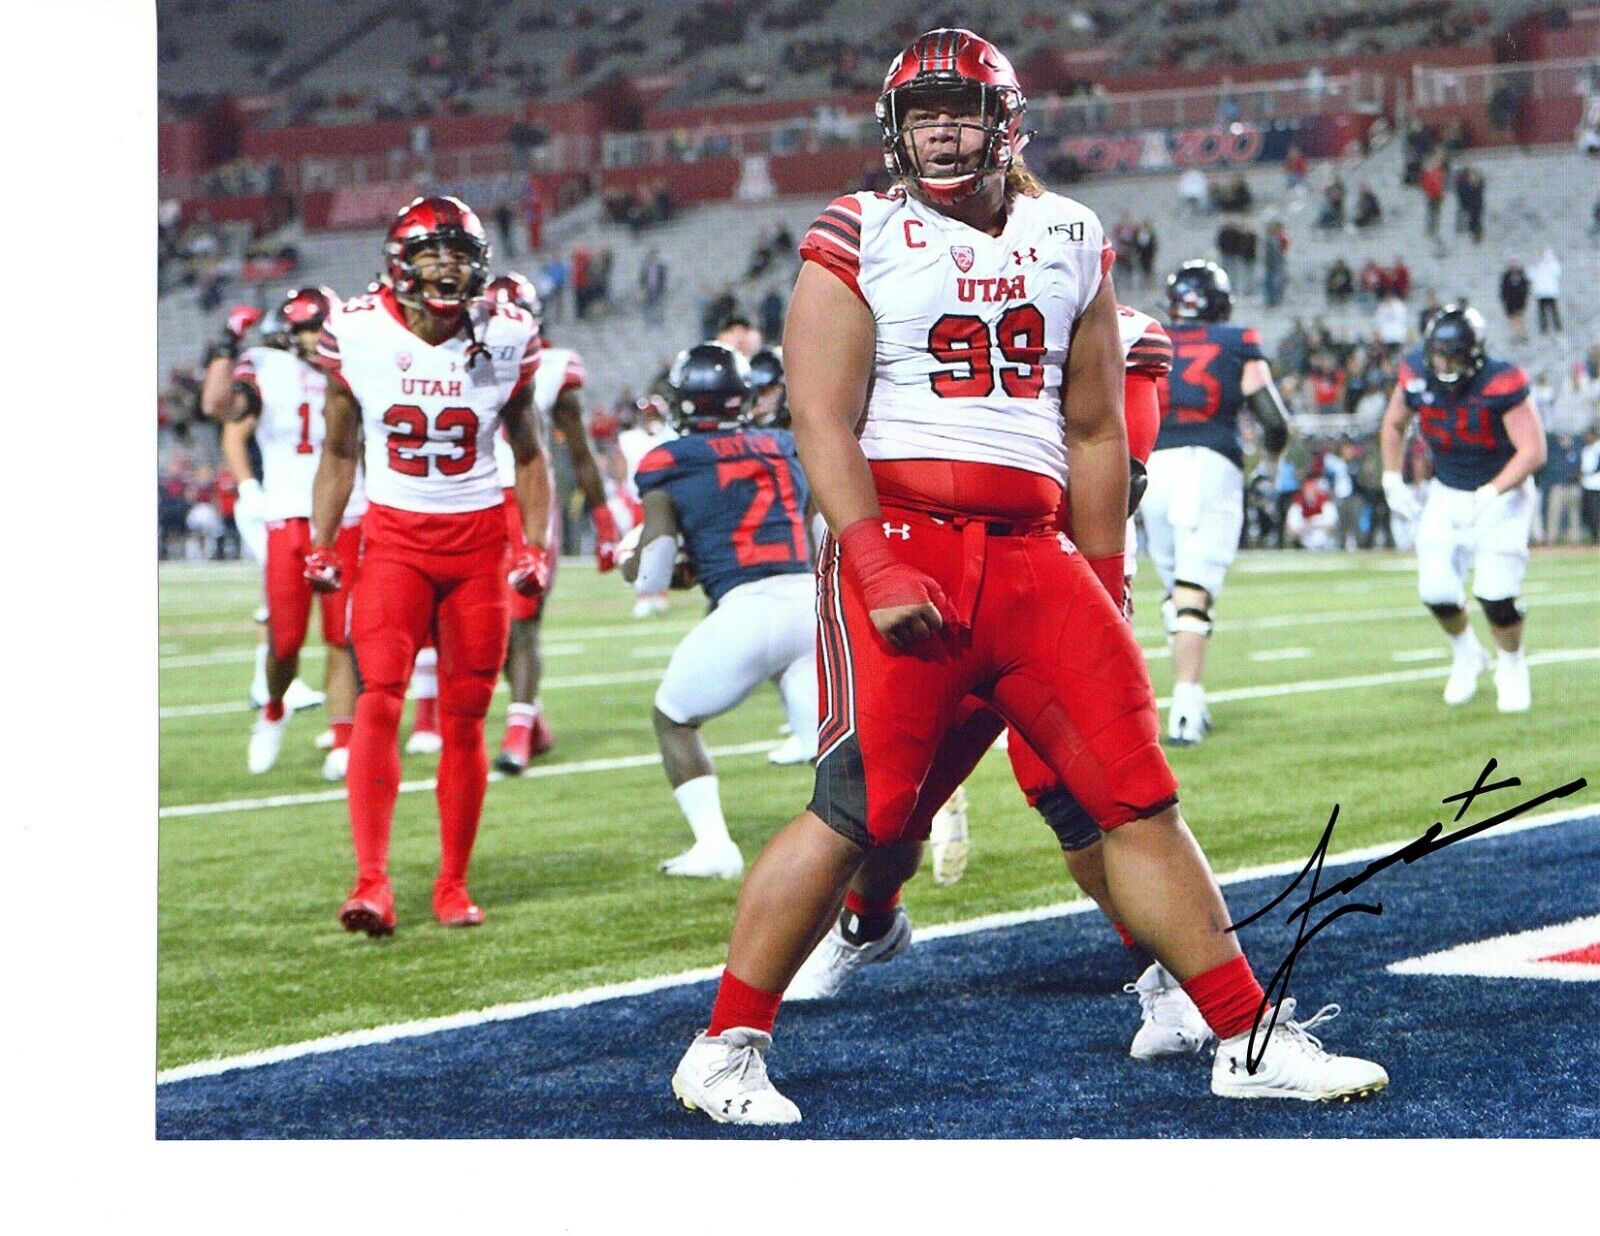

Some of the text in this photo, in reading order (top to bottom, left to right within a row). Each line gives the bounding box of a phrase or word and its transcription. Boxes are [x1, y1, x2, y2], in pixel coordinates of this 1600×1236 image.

[903, 220, 927, 249] C
[957, 274, 1027, 303] UTAH
[928, 304, 1048, 399] 99
[402, 377, 462, 397] UTAH
[383, 404, 479, 478] 23
[1418, 406, 1497, 453] 54
[715, 456, 808, 567] 21
